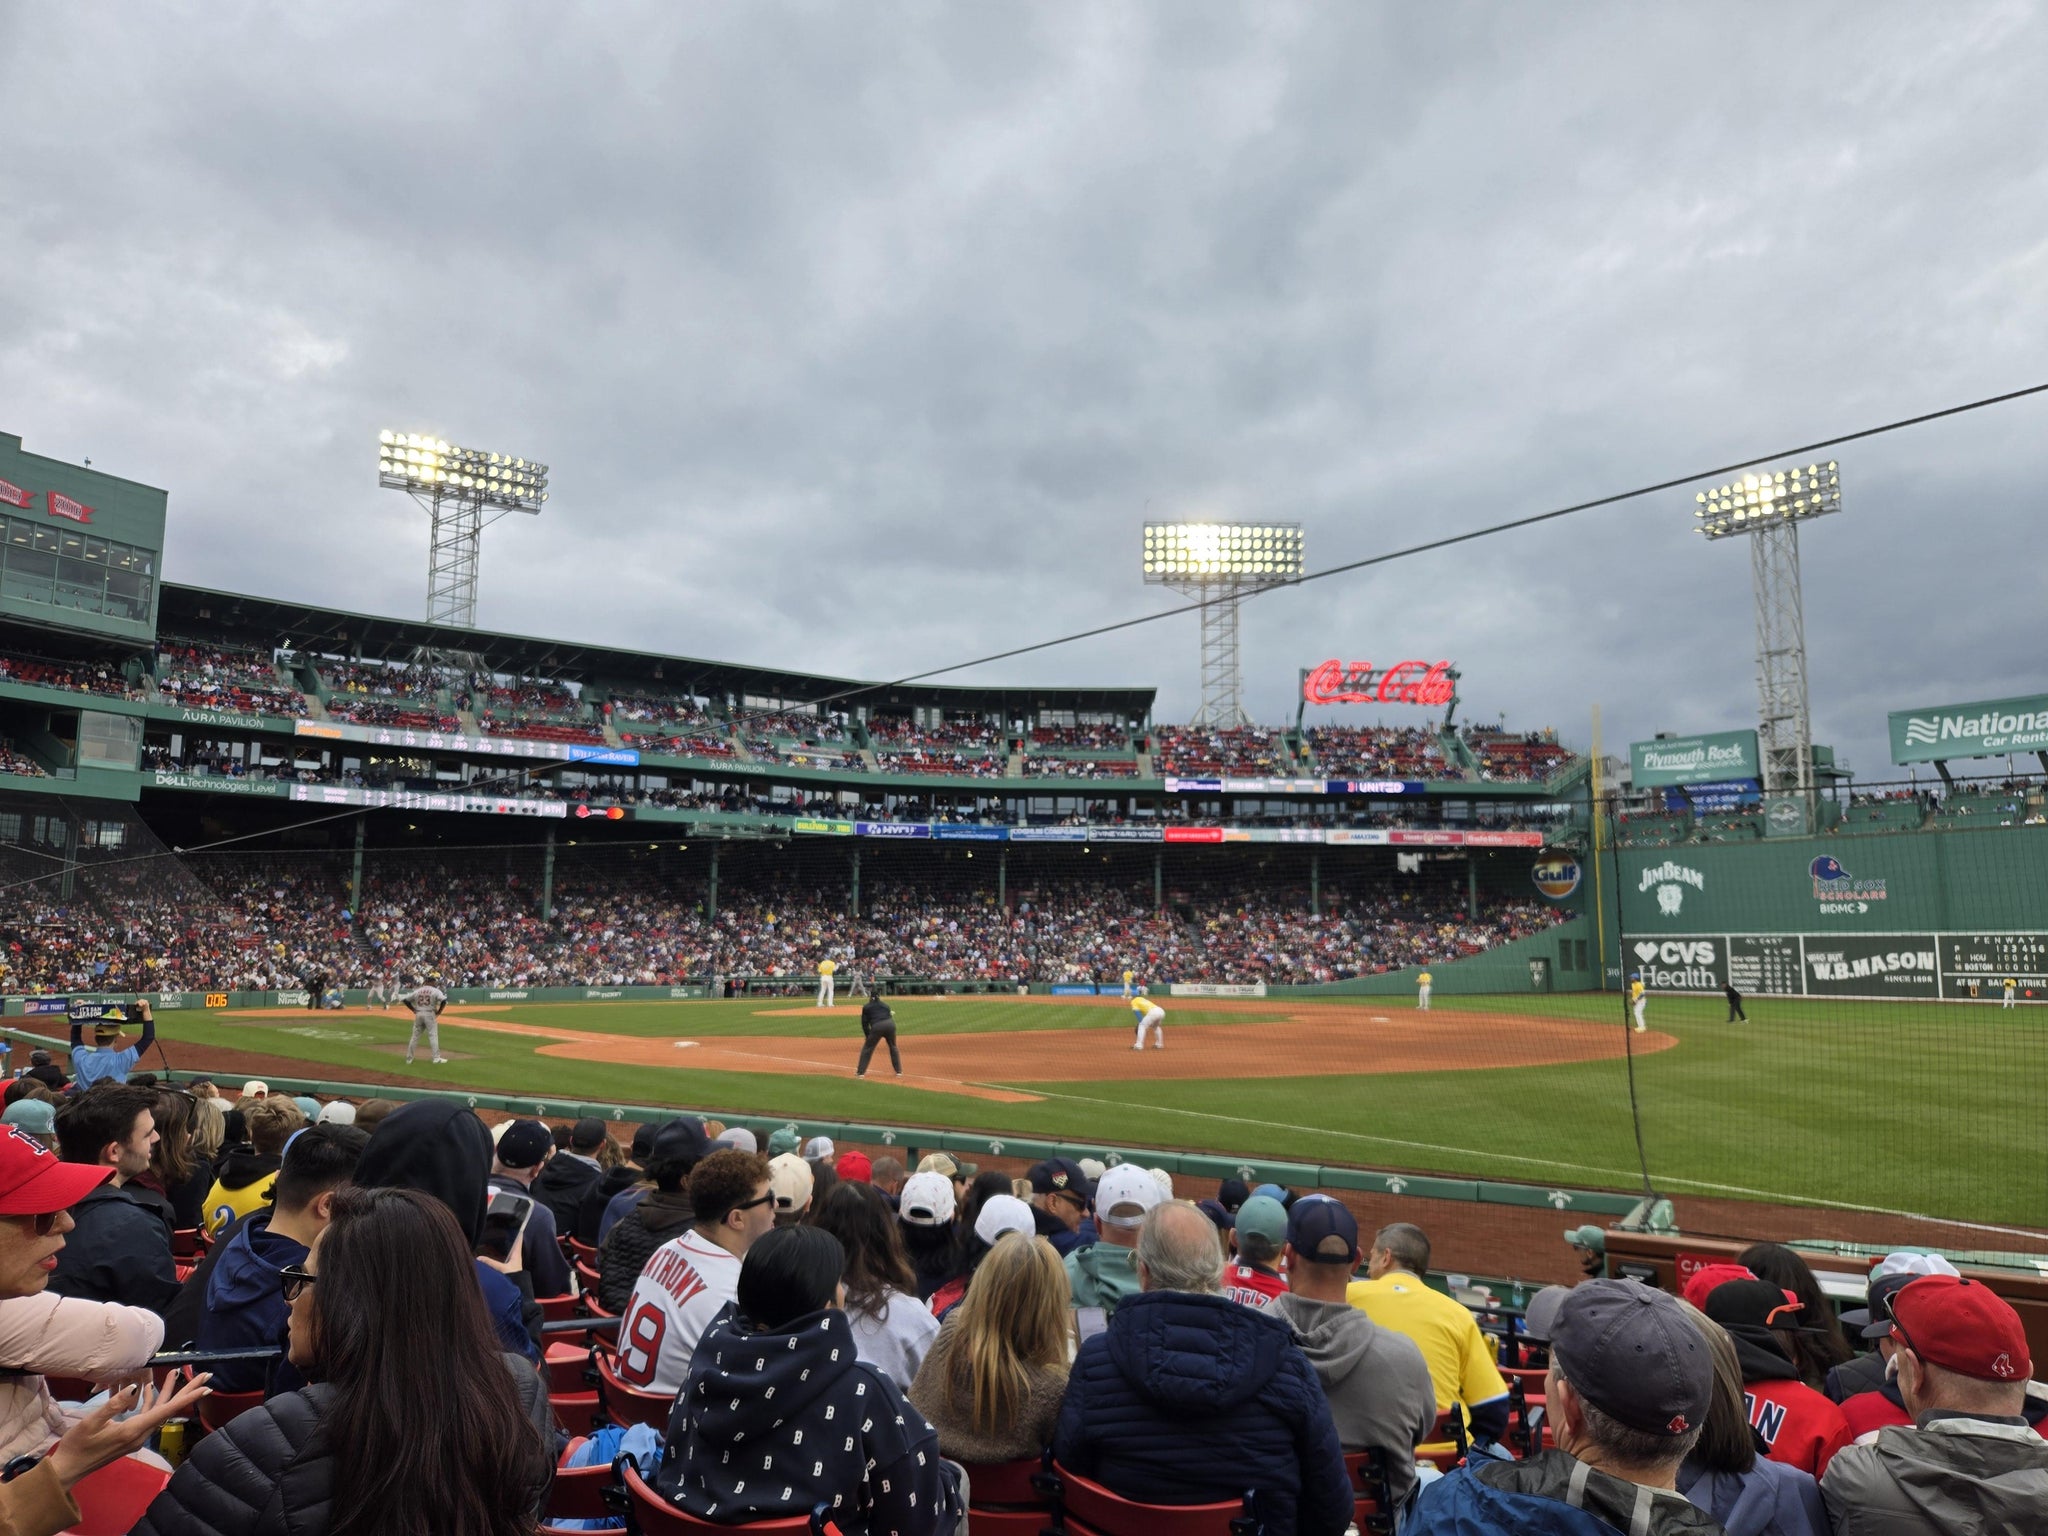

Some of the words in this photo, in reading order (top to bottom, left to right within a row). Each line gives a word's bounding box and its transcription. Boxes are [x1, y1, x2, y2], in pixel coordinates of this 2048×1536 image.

[1350, 663, 1372, 671] ENJOY
[219, 716, 265, 729] PAVILION
[1940, 711, 2048, 740] Nationa
[1983, 737, 2007, 747] Car
[2012, 732, 2048, 745] Rent
[1644, 748, 1705, 769] Plymouth
[1708, 742, 1743, 762] Rock
[156, 775, 187, 787] DELL
[187, 778, 250, 793] Technologies
[252, 783, 276, 794] Level
[1359, 781, 1405, 794] UNITED
[1535, 864, 1575, 881] Gulf
[1639, 867, 1664, 892] JIM
[1664, 861, 1704, 891] BEAM
[1819, 880, 1849, 891] RED
[1854, 880, 1886, 891] SOX
[1819, 890, 1887, 901] SCHOLARS
[1820, 903, 1855, 914] BIDMC
[1660, 941, 1715, 965] CVS
[1954, 945, 1960, 953] P
[2003, 945, 2008, 953] 2
[2011, 945, 2017, 953] 3
[2022, 945, 2028, 953] 4
[2030, 945, 2036, 953] 5
[2038, 945, 2045, 953] 6
[1970, 954, 1986, 962] HOU
[2004, 954, 2009, 962] 0
[2012, 954, 2018, 962] 0
[2023, 954, 2028, 962] 4
[1964, 963, 1993, 972] BOSTON
[2005, 964, 2010, 972] 0
[2013, 964, 2018, 972] 0
[2024, 964, 2029, 972] 0
[1637, 965, 1718, 989] Health
[1884, 975, 1911, 983] SINCE
[1956, 979, 1966, 987] AT
[1967, 979, 1981, 987] BAT
[1988, 979, 2004, 987] BAL
[2018, 979, 2047, 988] STRIKE
[489, 991, 528, 999] smartwater
[8, 1127, 49, 1156] B
[642, 1247, 708, 1309] NTHONY
[613, 1291, 667, 1388] 19
[1744, 1391, 1787, 1446] N
